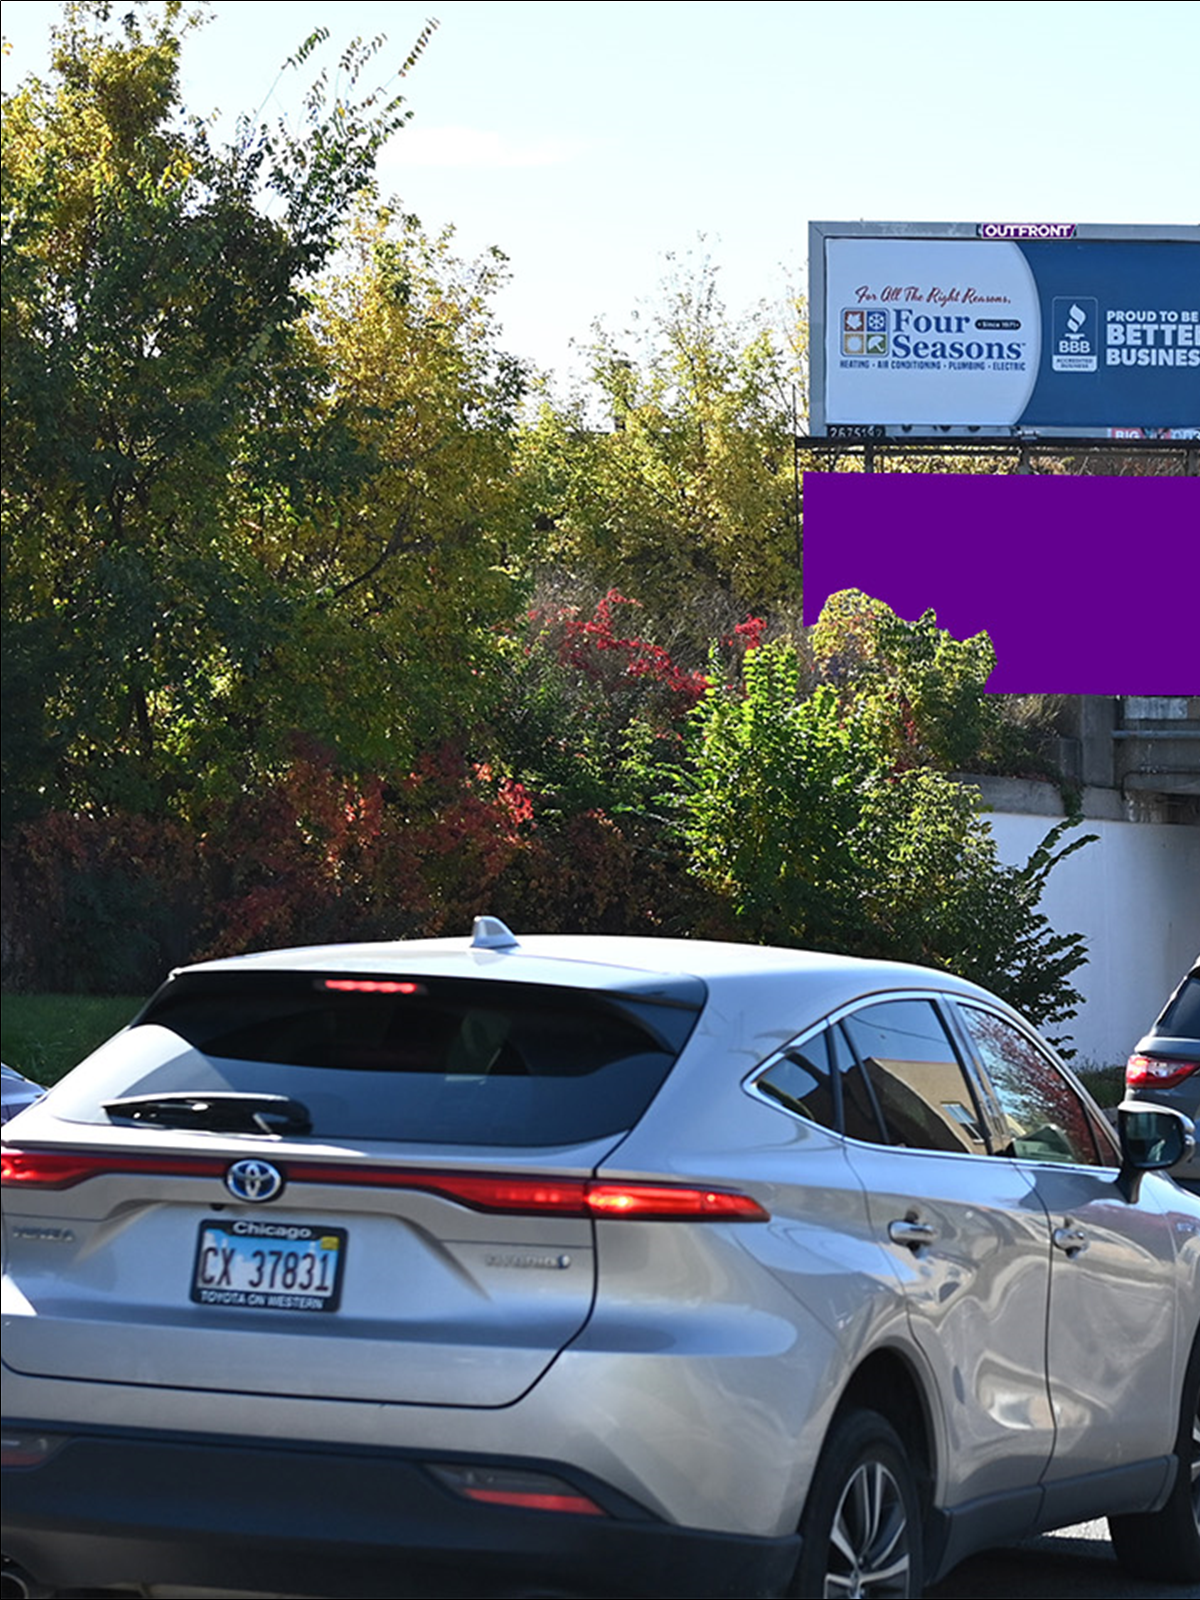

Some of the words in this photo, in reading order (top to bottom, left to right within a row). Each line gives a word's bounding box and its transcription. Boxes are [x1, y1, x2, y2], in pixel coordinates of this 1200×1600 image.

[984, 224, 1071, 237] OUTFRONT
[854, 285, 877, 304] For
[880, 285, 900, 303] All
[903, 286, 923, 302] The
[926, 287, 960, 307] Right
[892, 308, 970, 333] Four
[1106, 310, 1157, 322] PROUD
[1159, 311, 1179, 322] TO
[1181, 311, 1199, 322] BE
[892, 334, 1022, 360] Seasons
[1059, 340, 1091, 353] BBB
[840, 360, 870, 369] HEATING
[877, 360, 889, 369] AIR
[891, 360, 941, 370] CONDITIONING
[948, 361, 985, 371] PLUMBING
[992, 362, 1026, 371] ELECTRIC
[233, 1221, 312, 1240] Chicago
[202, 1246, 236, 1286] CX
[248, 1250, 329, 1292] 37831
[200, 1290, 246, 1304] TOYOTA
[247, 1294, 266, 1306] ON
[267, 1296, 324, 1309] WESTERN
